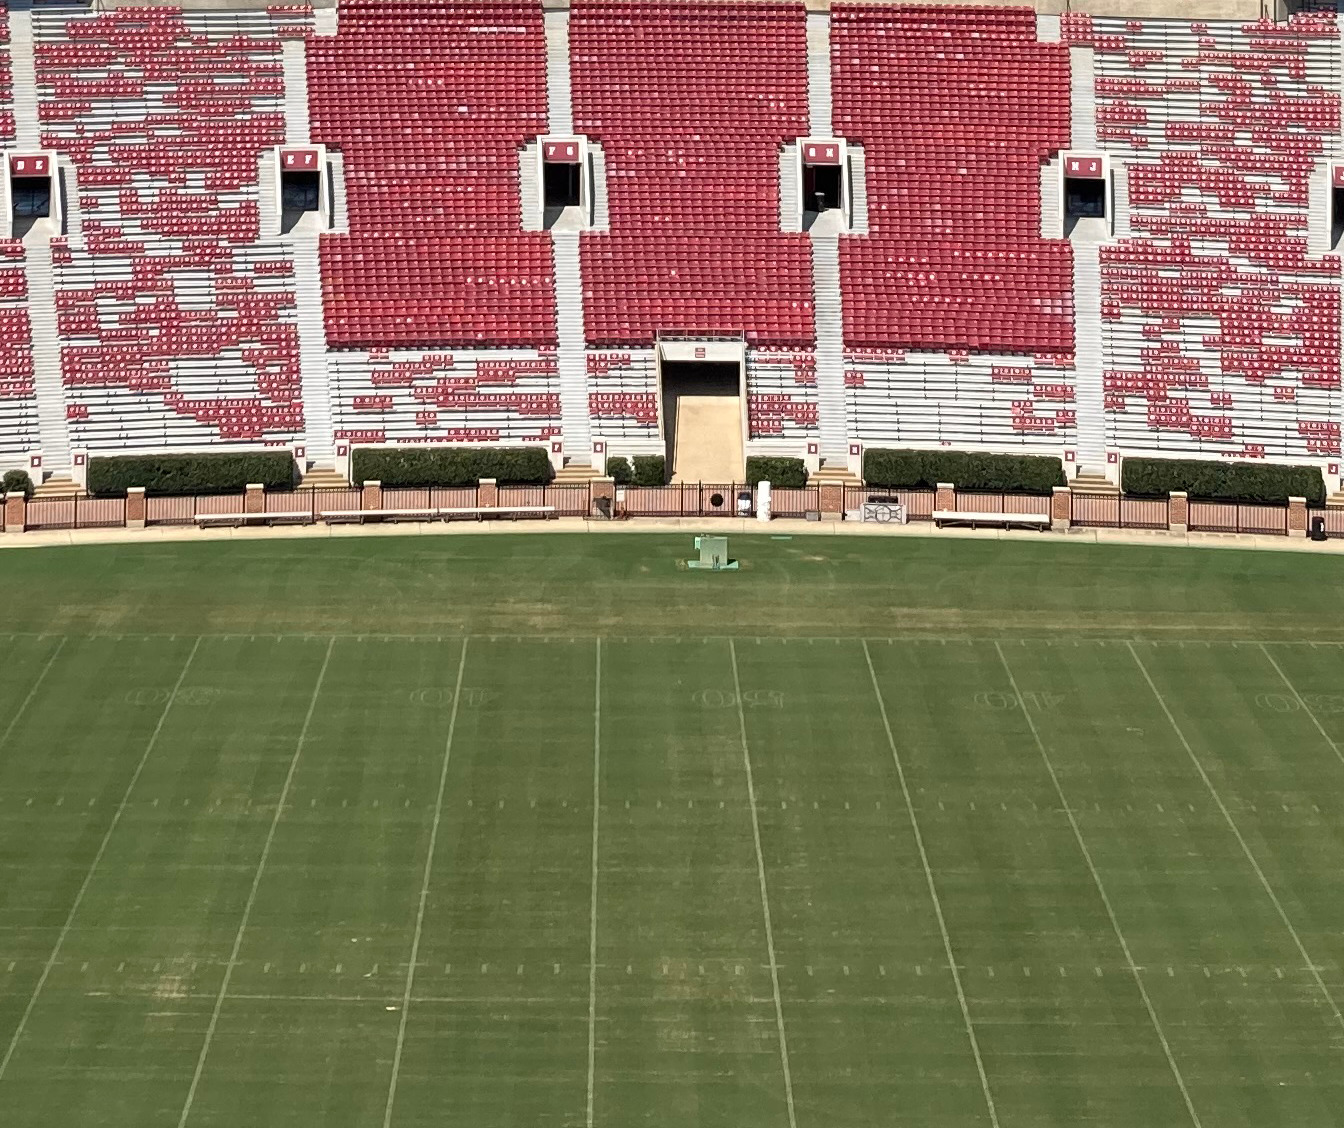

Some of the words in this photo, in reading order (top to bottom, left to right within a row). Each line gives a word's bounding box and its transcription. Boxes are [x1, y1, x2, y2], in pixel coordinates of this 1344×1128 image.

[549, 147, 555, 155] F
[287, 155, 294, 164] E
[305, 155, 312, 164] F
[36, 161, 43, 169] E
[1090, 162, 1096, 171] J
